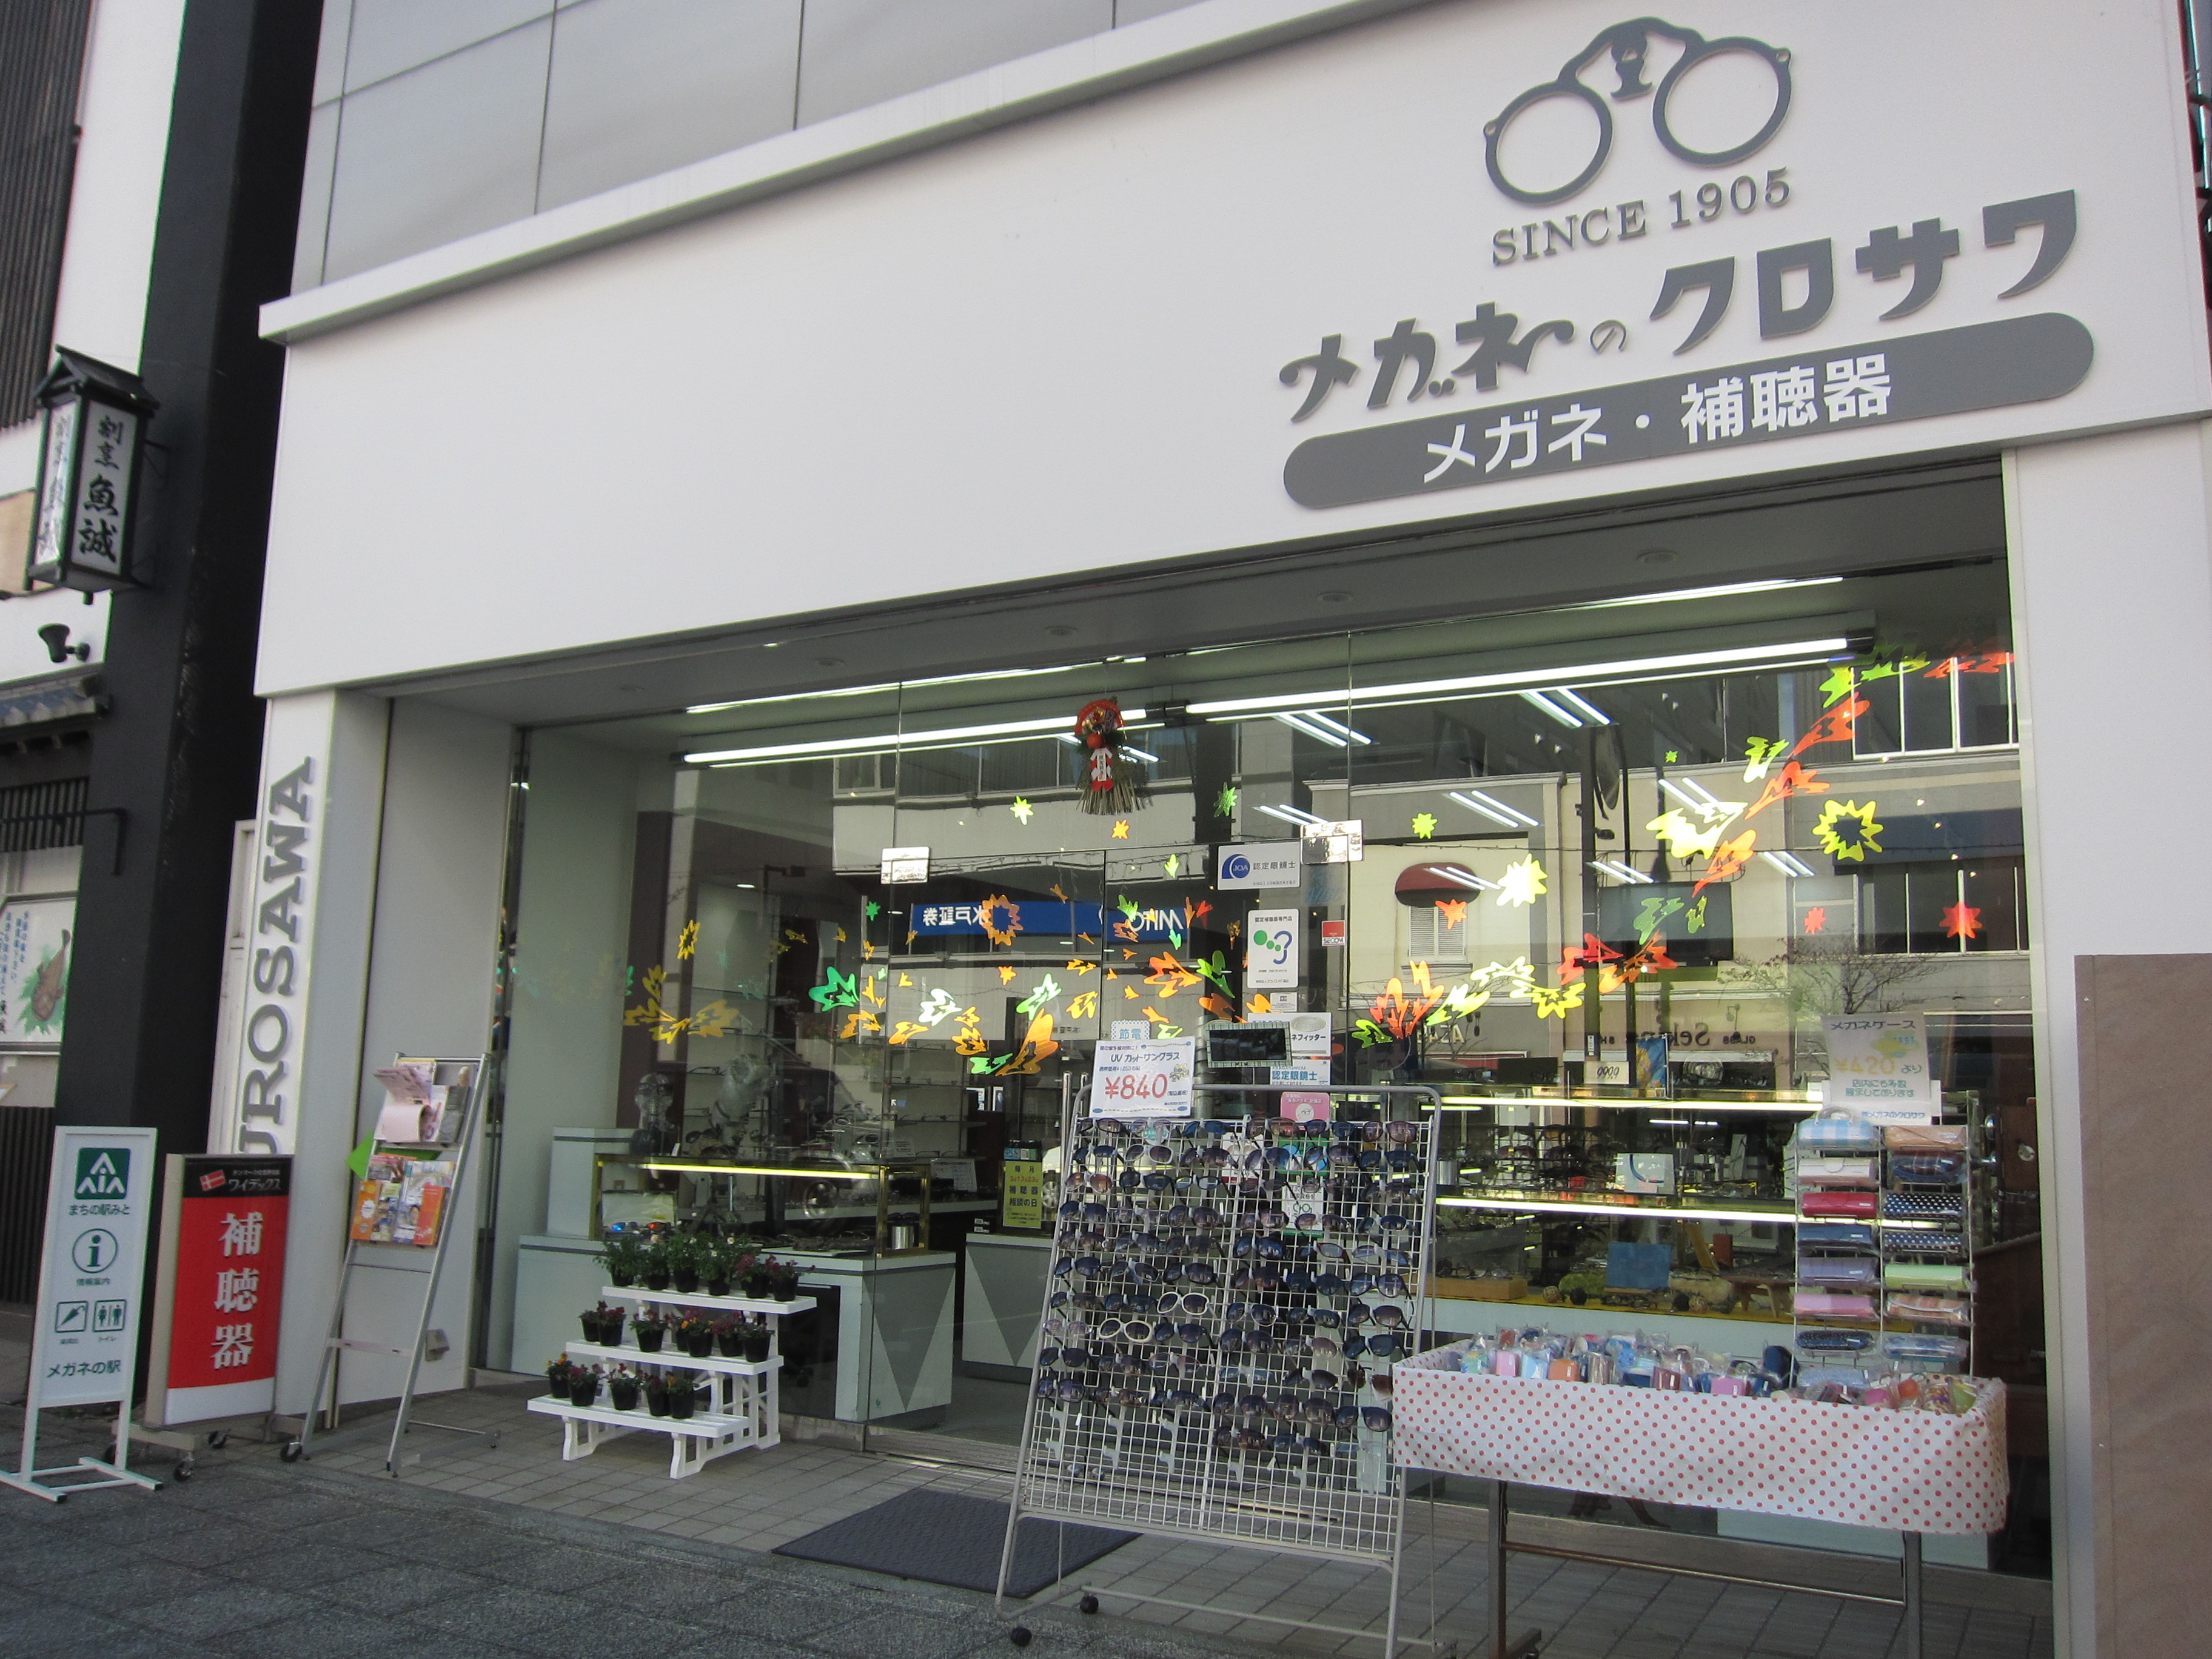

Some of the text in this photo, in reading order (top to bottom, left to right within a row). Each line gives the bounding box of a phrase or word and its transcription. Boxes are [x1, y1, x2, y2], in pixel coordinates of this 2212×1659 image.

[1492, 167, 1792, 265] SINCE 1905
[1423, 352, 1892, 484] メガネ・補聴器
[1253, 861, 1296, 870] 認定眼鏡士
[239, 756, 314, 1153] UROSAWA
[1831, 1020, 1916, 1030] メガネケース
[1119, 1028, 1141, 1040] 節電
[1272, 1070, 1318, 1081] 認定眼鏡士
[1597, 1065, 1620, 1079] 999.9
[1105, 1073, 1168, 1099] ¥840
[228, 1178, 281, 1191] ワイデックス
[1009, 1198, 1037, 1207] 相談の日
[69, 1204, 130, 1216] まちの駅みと
[211, 1212, 264, 1370] 補聴器
[47, 1360, 121, 1378] メガネの駅
